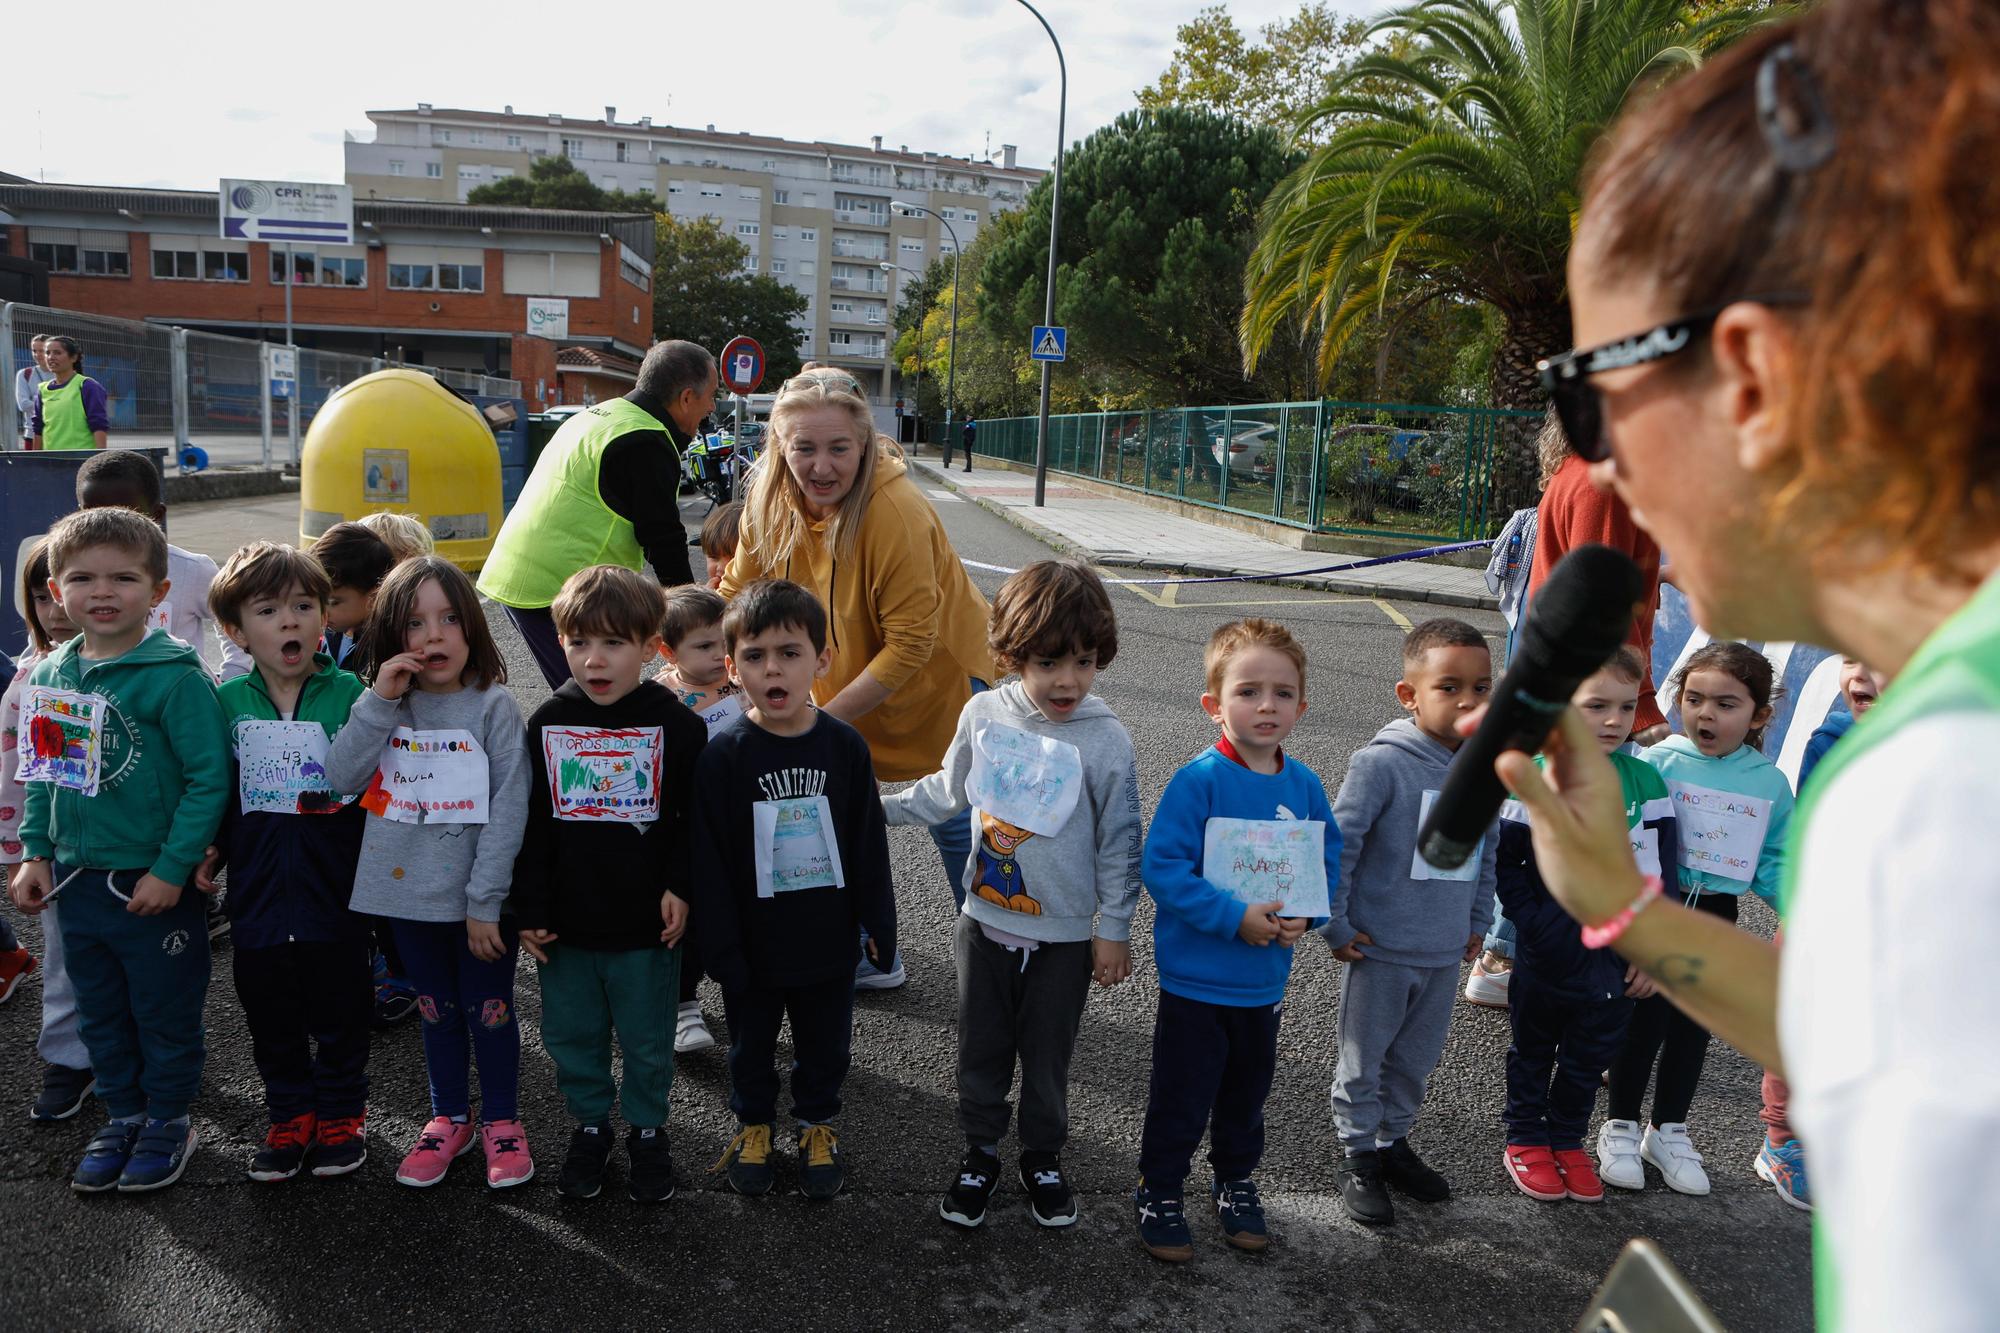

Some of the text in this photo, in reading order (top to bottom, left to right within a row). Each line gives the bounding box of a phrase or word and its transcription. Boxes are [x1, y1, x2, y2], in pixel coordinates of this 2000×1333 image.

[275, 187, 303, 199] CPR
[613, 738, 655, 751] DACAL
[282, 750, 302, 763] 43
[593, 758, 611, 770] 47
[286, 778, 332, 790] NICOLA
[393, 771, 434, 784] PAULA
[793, 807, 819, 821] DAC
